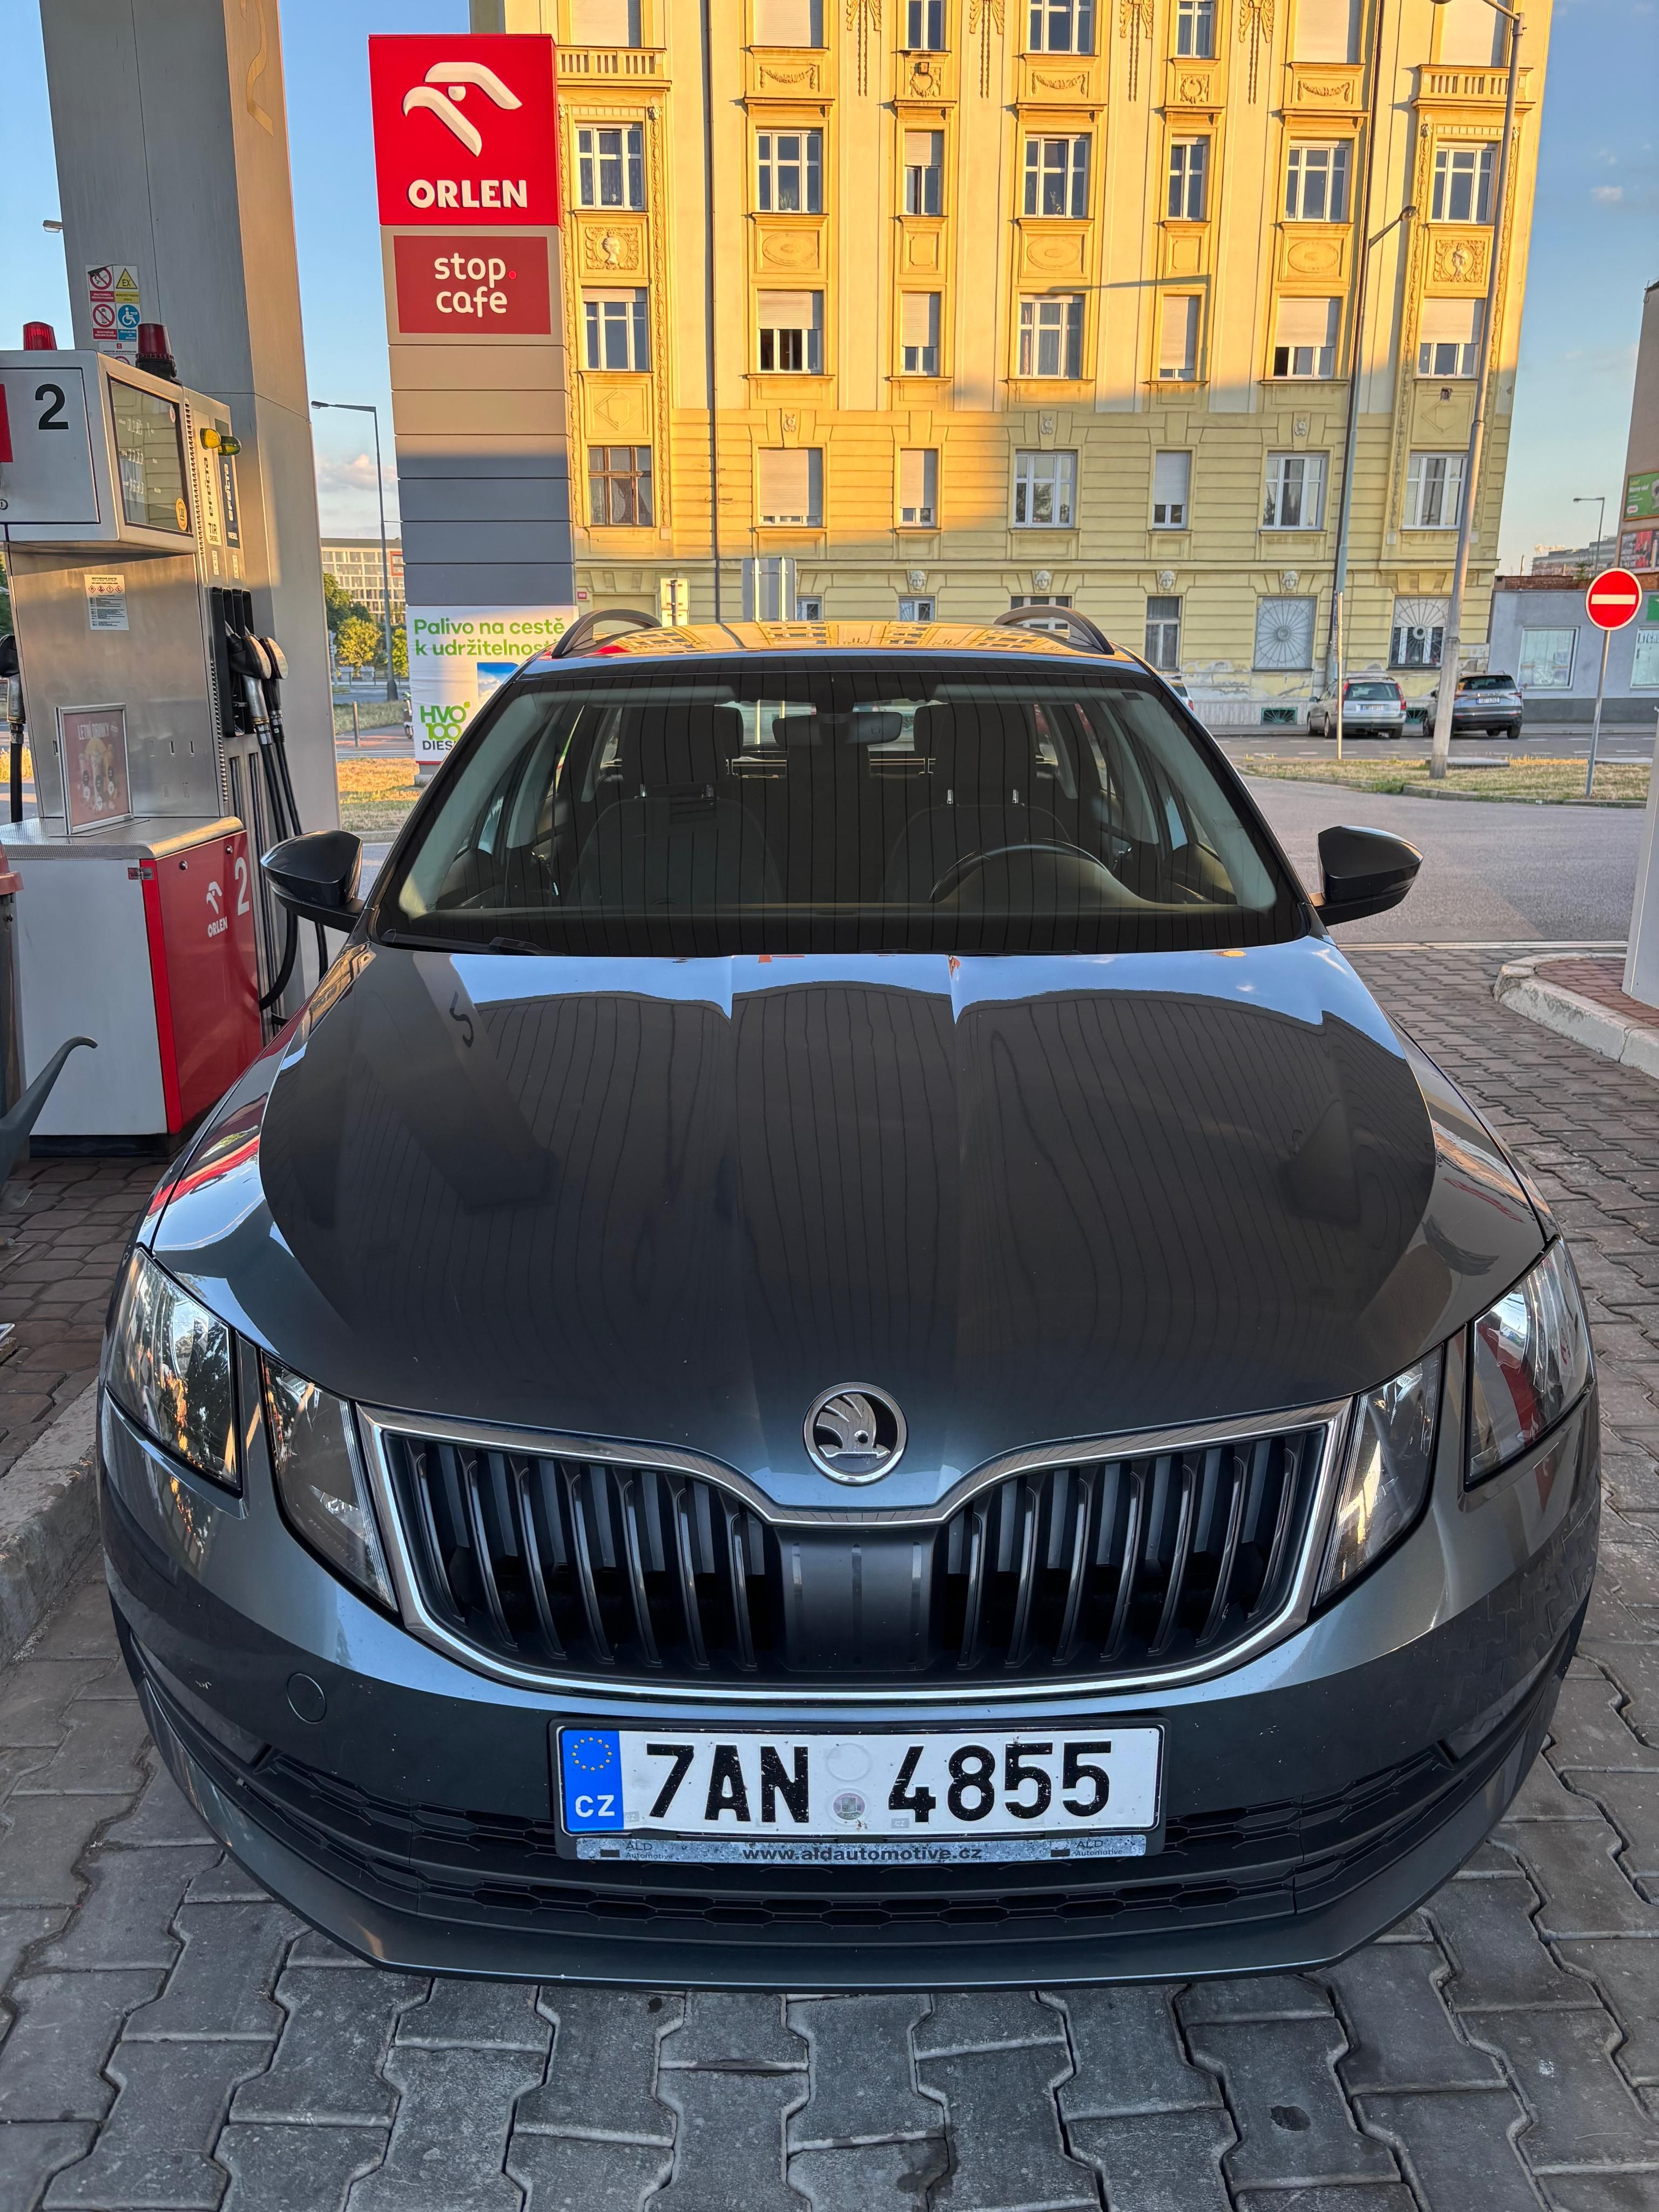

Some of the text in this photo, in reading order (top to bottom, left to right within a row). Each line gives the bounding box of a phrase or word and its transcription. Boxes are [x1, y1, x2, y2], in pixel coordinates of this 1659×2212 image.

[408, 179, 527, 208] ORLEN
[436, 286, 508, 318] cafe
[35, 384, 69, 429] 2
[208, 523, 218, 535] TIR
[414, 617, 565, 635] Palivo na cestě
[415, 639, 557, 656] k udržitelnos
[420, 705, 467, 724] HVO
[426, 723, 462, 741] 100
[422, 740, 456, 750] DIES
[234, 857, 249, 916] 2
[207, 916, 228, 938] ORLEN
[575, 1741, 1112, 1823] CZ 7AN 4855
[626, 1840, 652, 1851] ALD
[1075, 1849, 1123, 1857] Automotive
[1076, 1839, 1103, 1849] ALD
[626, 1852, 673, 1860] Automotive
[743, 1846, 982, 1861] www.aldautomotive.cz
